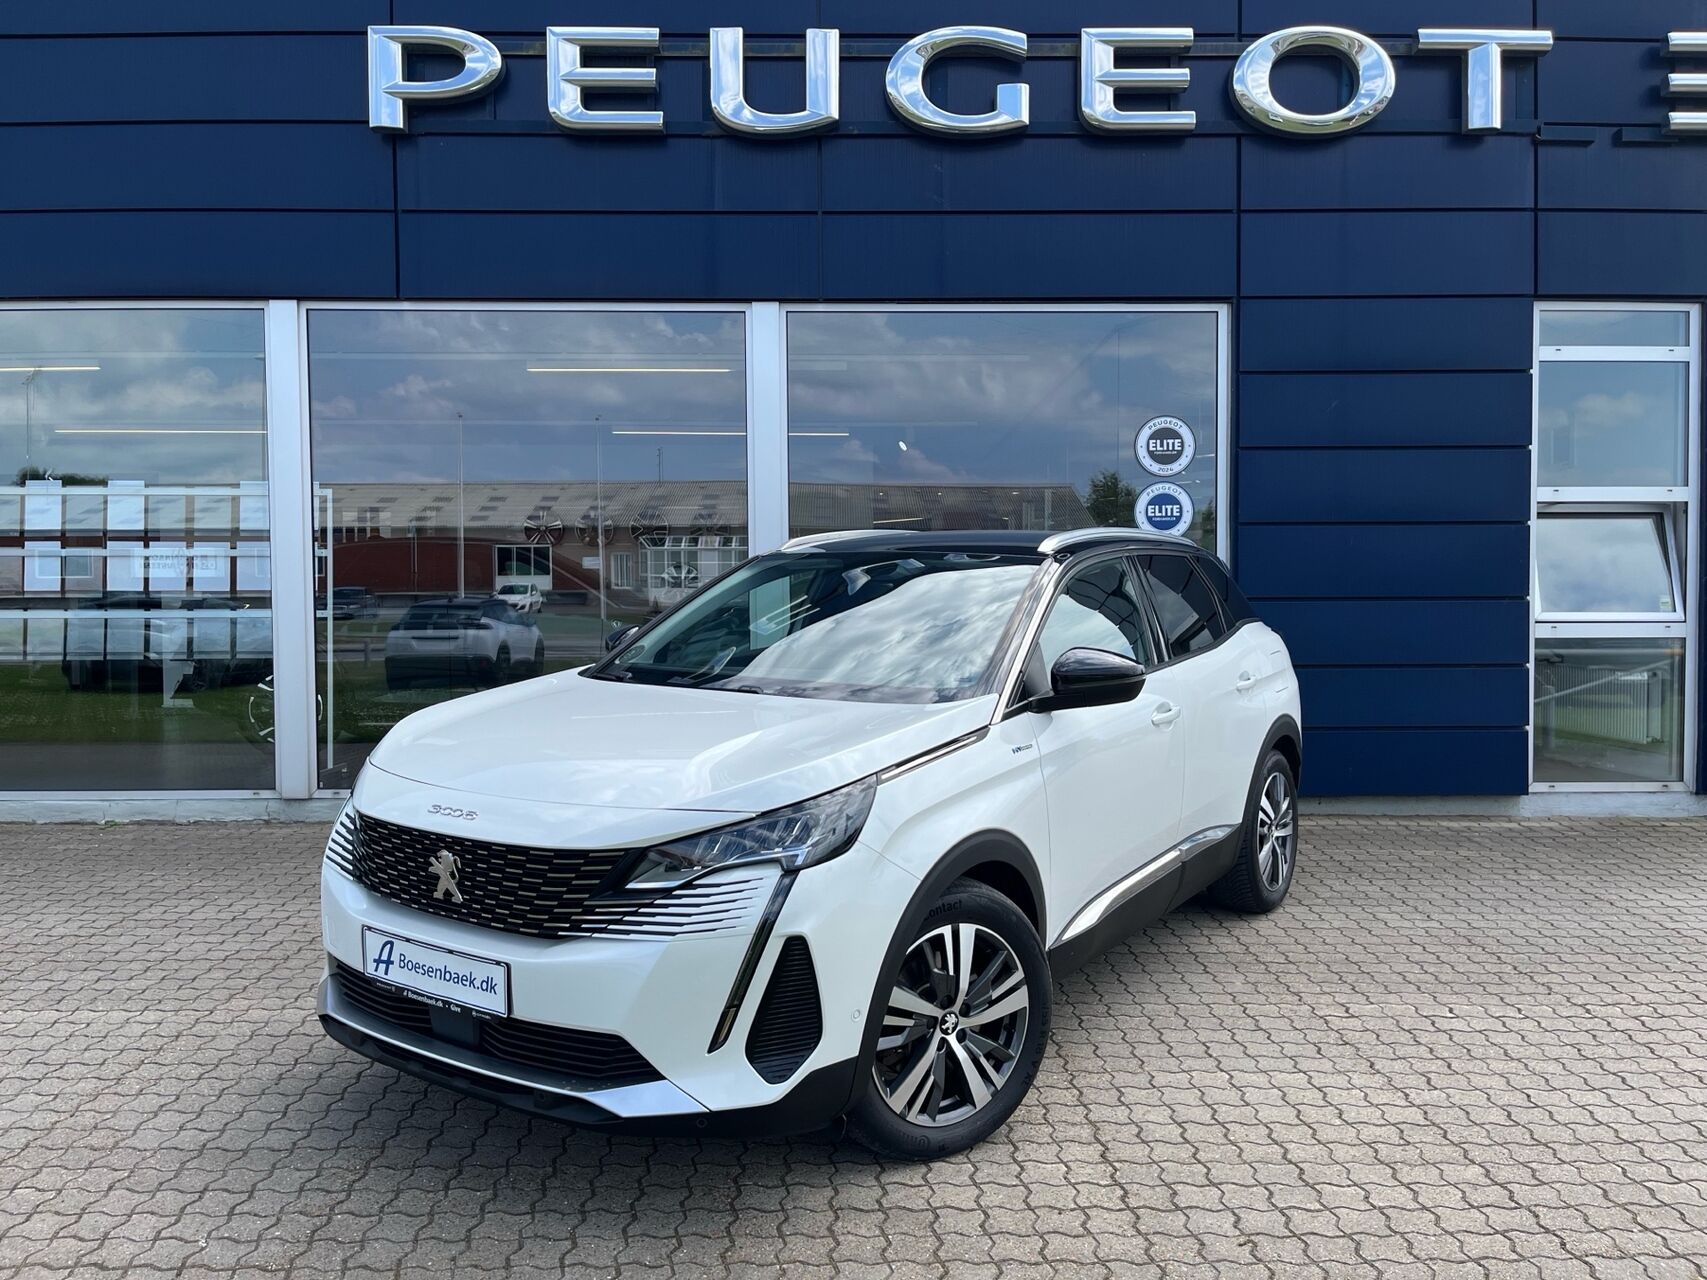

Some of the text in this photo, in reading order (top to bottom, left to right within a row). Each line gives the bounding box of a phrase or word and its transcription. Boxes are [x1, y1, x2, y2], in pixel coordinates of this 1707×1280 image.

[367, 25, 1554, 137] PEUGEOT
[1148, 419, 1183, 430] PEUGEOT
[1149, 439, 1182, 451] ELITE
[1146, 485, 1182, 497] PEUGEOT
[1147, 505, 1180, 517] ELITE
[427, 804, 478, 820] 3008
[398, 953, 498, 995] Boesenbaek.dk
[407, 991, 444, 1008] Boesenbaek.dk
[450, 1003, 462, 1013] Give
